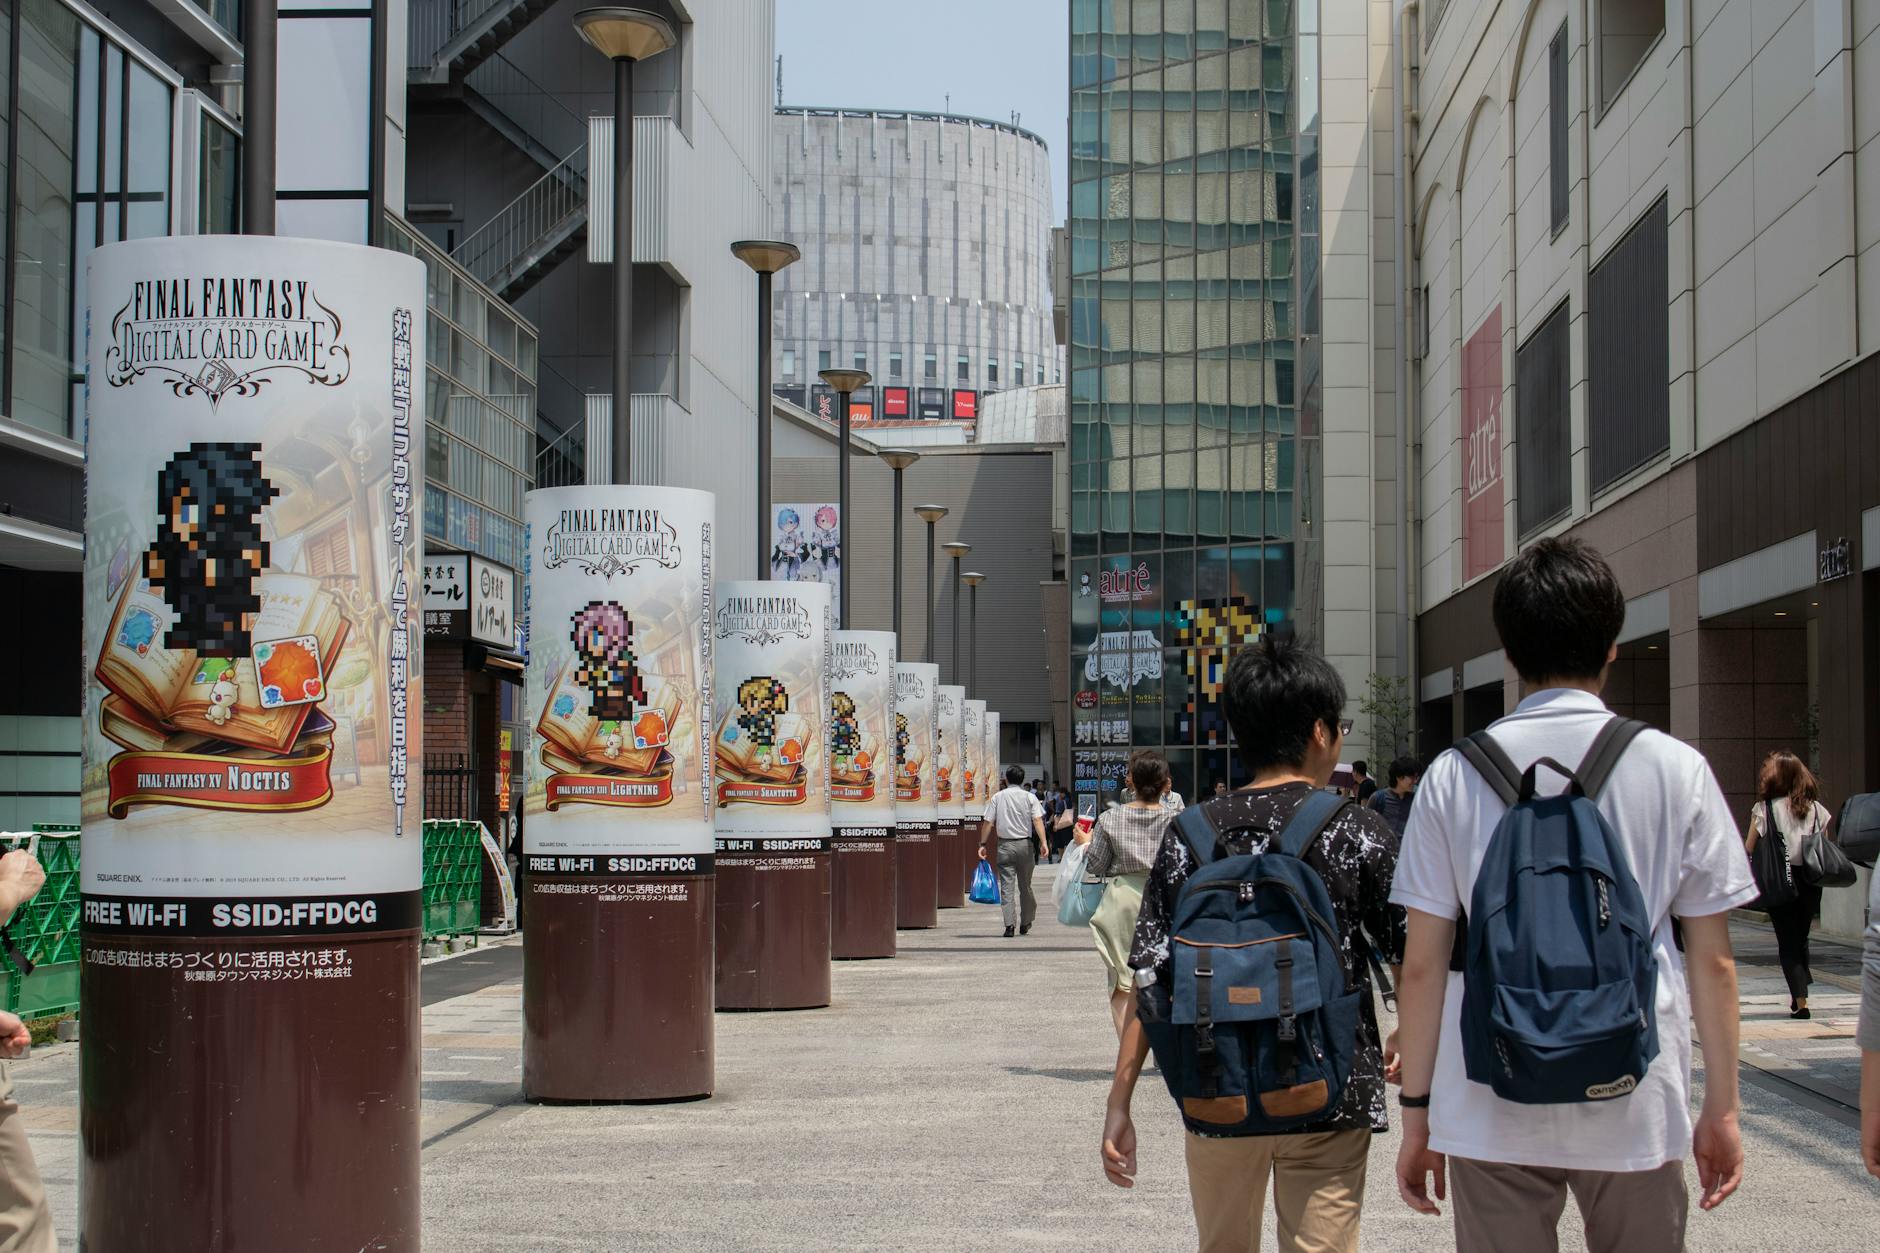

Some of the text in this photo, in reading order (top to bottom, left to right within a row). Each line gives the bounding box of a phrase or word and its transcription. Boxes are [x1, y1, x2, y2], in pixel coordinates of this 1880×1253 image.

[135, 278, 309, 321] FINAL FANTASY
[119, 322, 326, 372] DIGITAL CARD GAME
[561, 509, 660, 532] FINAL FANTASY
[554, 533, 669, 560] DIGITAL CARD GAME
[1100, 561, 1151, 594] atré
[728, 597, 797, 614] FINAL FANTASY
[425, 612, 452, 625] 議室
[723, 613, 804, 633] DIGITAL CARD GAME
[836, 642, 867, 657] FANTASY
[1075, 720, 1129, 743] 対戦型
[137, 773, 162, 788] FINAL
[164, 773, 207, 788] FANTASY
[208, 774, 223, 788] XV
[556, 785, 571, 795] FINAL
[571, 785, 596, 795] FANTASY
[840, 828, 887, 837] SSID:FFDCG
[763, 839, 822, 850] SSID:FFDCG
[529, 857, 696, 872] FREE Wi-Fi SSID:FFDCG
[97, 873, 122, 882] SQUARE
[533, 884, 688, 894] この広告収益はまちづくりに活用されます。
[84, 899, 377, 927] FREE Wi-Fi SSID:FFDCG
[86, 948, 353, 969] この広告収益はまちづくりに活用されます。
[184, 966, 353, 982] 秋葉原タウンマネジメント株式会社
